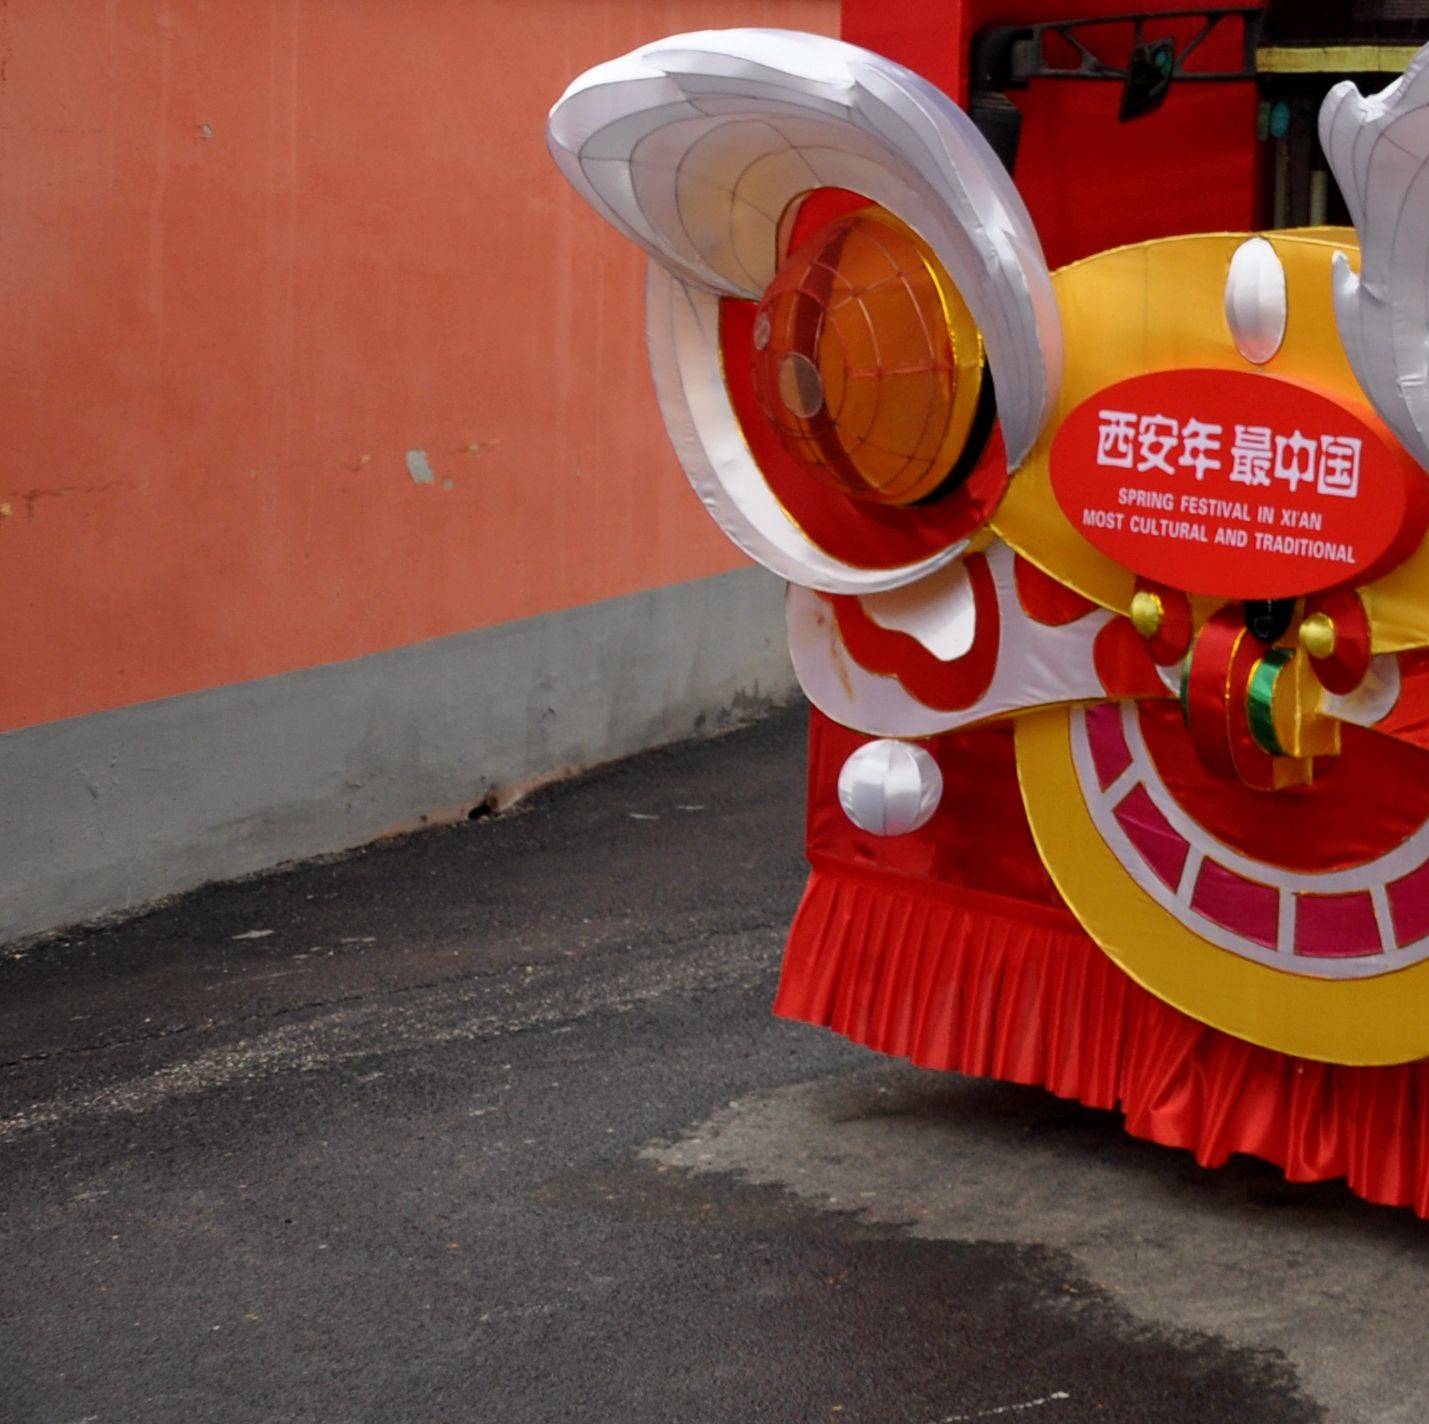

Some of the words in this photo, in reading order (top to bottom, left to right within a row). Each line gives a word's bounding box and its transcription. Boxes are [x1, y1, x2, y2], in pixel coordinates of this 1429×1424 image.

[1097, 410, 1222, 481] 西安年
[1229, 424, 1362, 499] 最中国
[1083, 508, 1124, 531] MOST
[1130, 515, 1208, 543] CULTURAL
[1214, 528, 1248, 548] AND
[1255, 532, 1356, 564] TRADITIONAL
[1118, 487, 1174, 511] SPRING
[1180, 495, 1251, 522] FESTIVAL
[1258, 506, 1274, 525] IN
[1280, 508, 1322, 531] XI'AN
